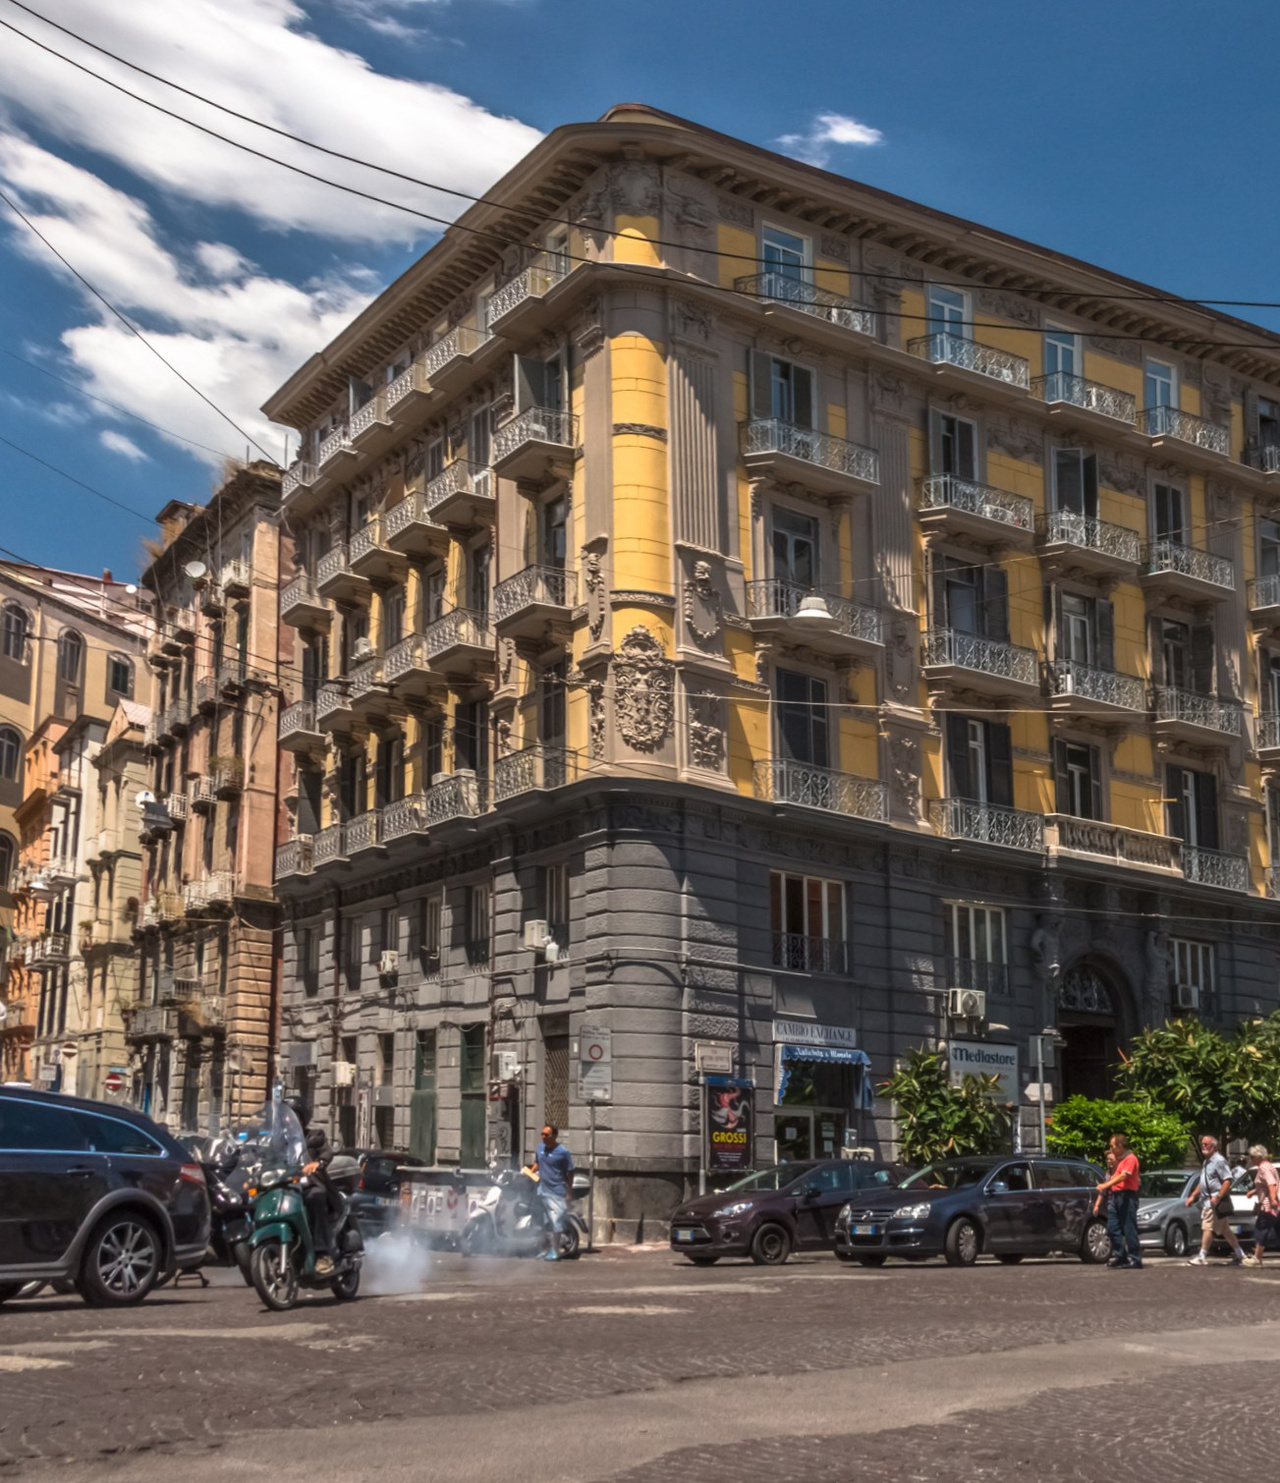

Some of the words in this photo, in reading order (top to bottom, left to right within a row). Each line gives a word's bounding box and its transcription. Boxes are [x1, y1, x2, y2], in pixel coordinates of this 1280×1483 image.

[776, 1021, 809, 1037] CAMBIO
[810, 1025, 853, 1042] EXCHANGE
[952, 1047, 1016, 1066] Mediastore
[712, 1131, 747, 1144] GROSSI
